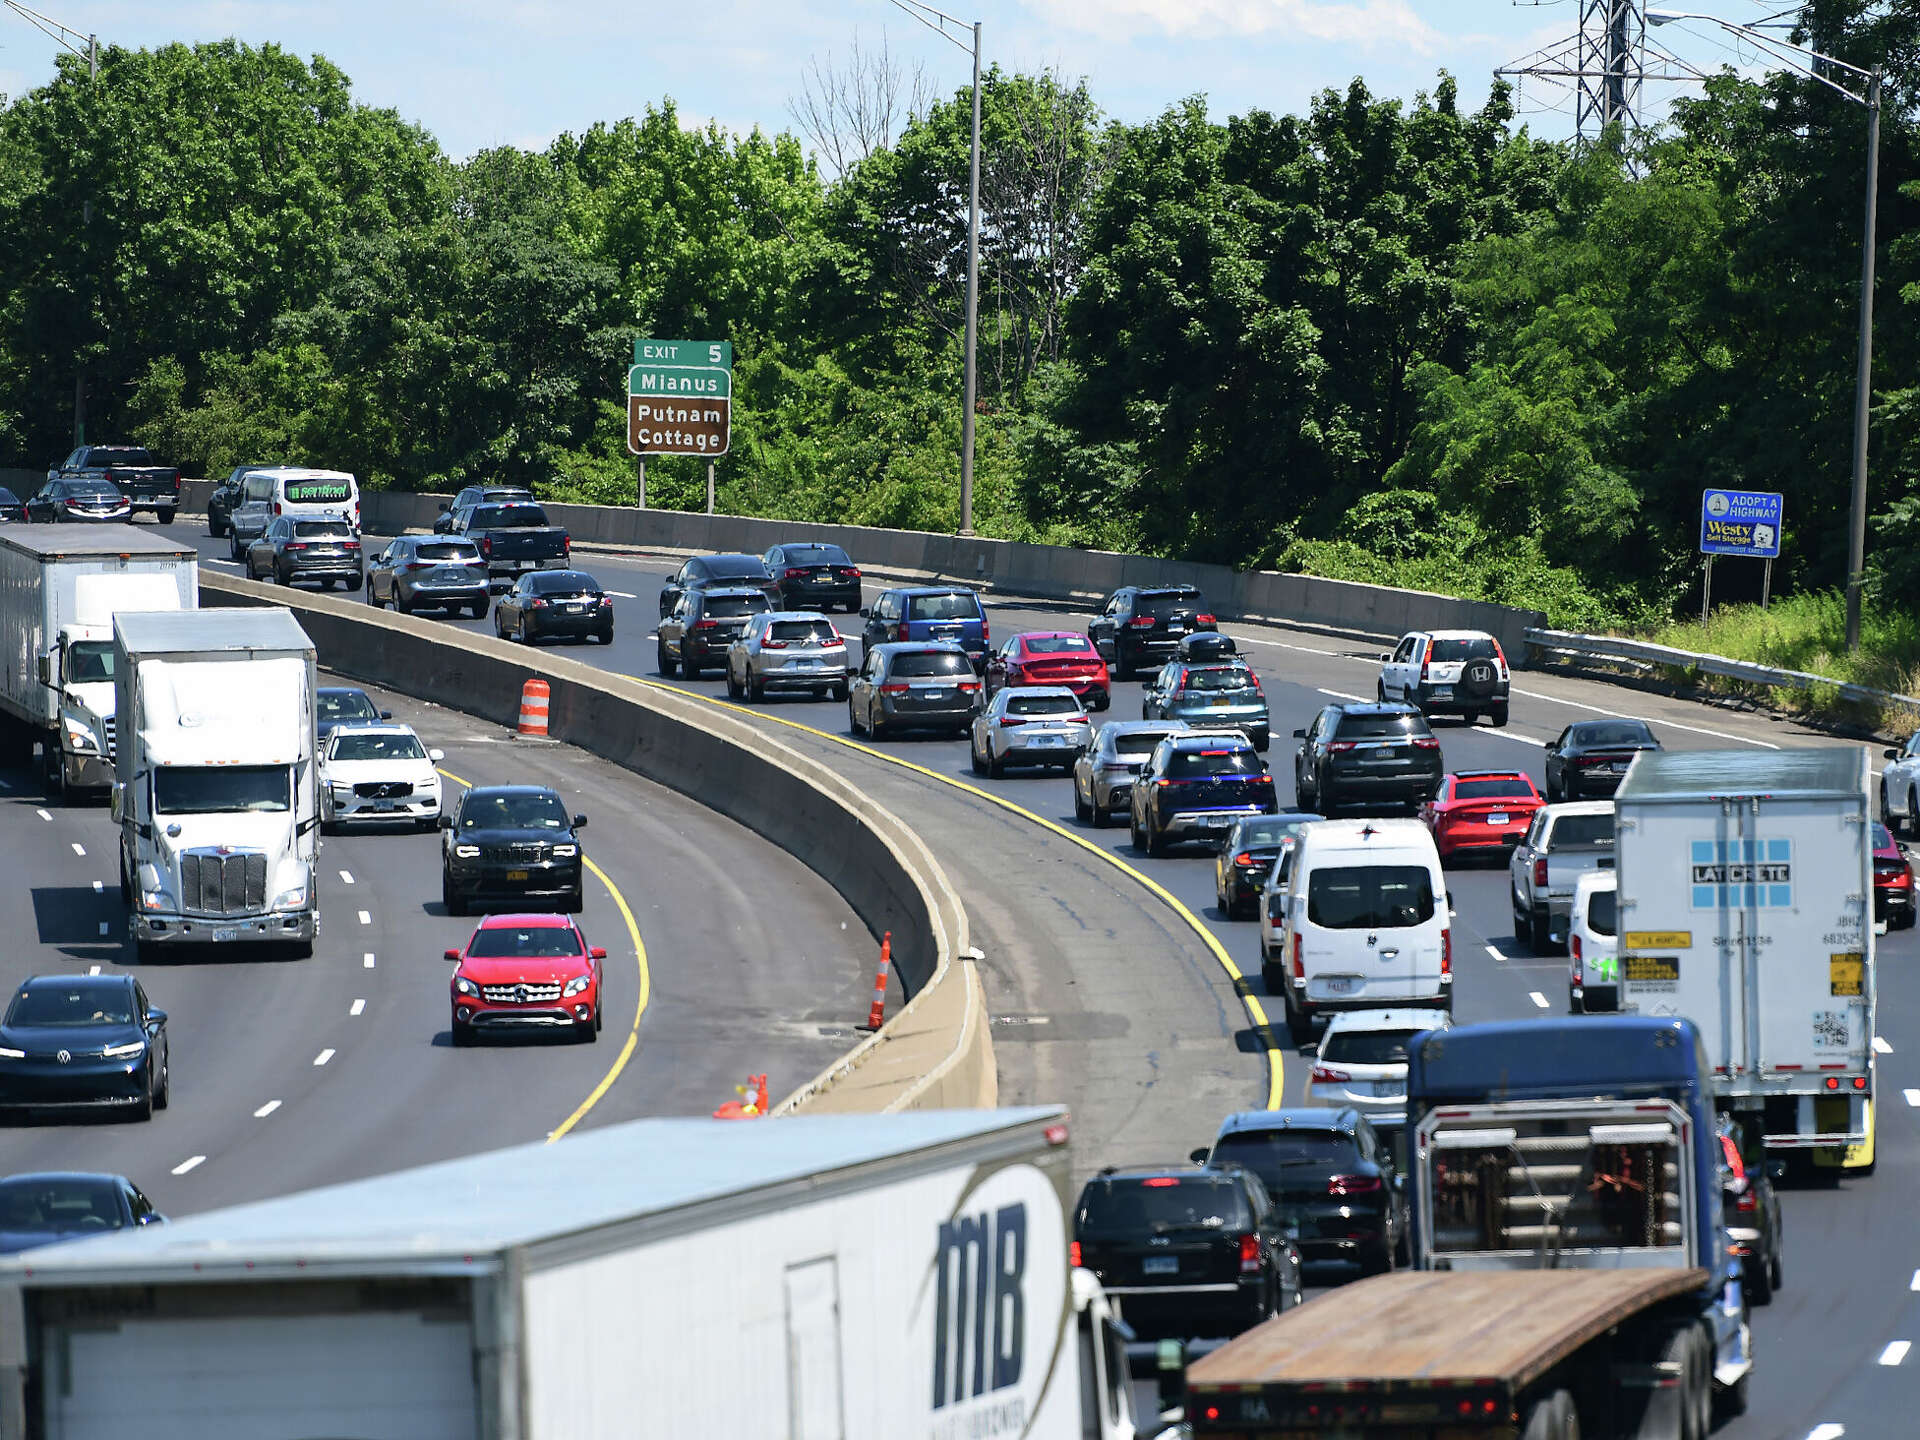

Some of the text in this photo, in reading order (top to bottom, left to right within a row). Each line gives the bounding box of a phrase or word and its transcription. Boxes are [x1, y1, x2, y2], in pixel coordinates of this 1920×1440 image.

[643, 345, 722, 363] EXIT 5
[641, 374, 718, 392] Mianus
[638, 405, 720, 423] Putnam
[638, 428, 720, 451] Cottage
[1731, 496, 1777, 508] ADOPT A
[1729, 507, 1777, 518] HIGHWAY
[1708, 521, 1752, 536] Westy
[1706, 533, 1751, 545] Self Storage
[1694, 865, 1789, 882] LATCRETE
